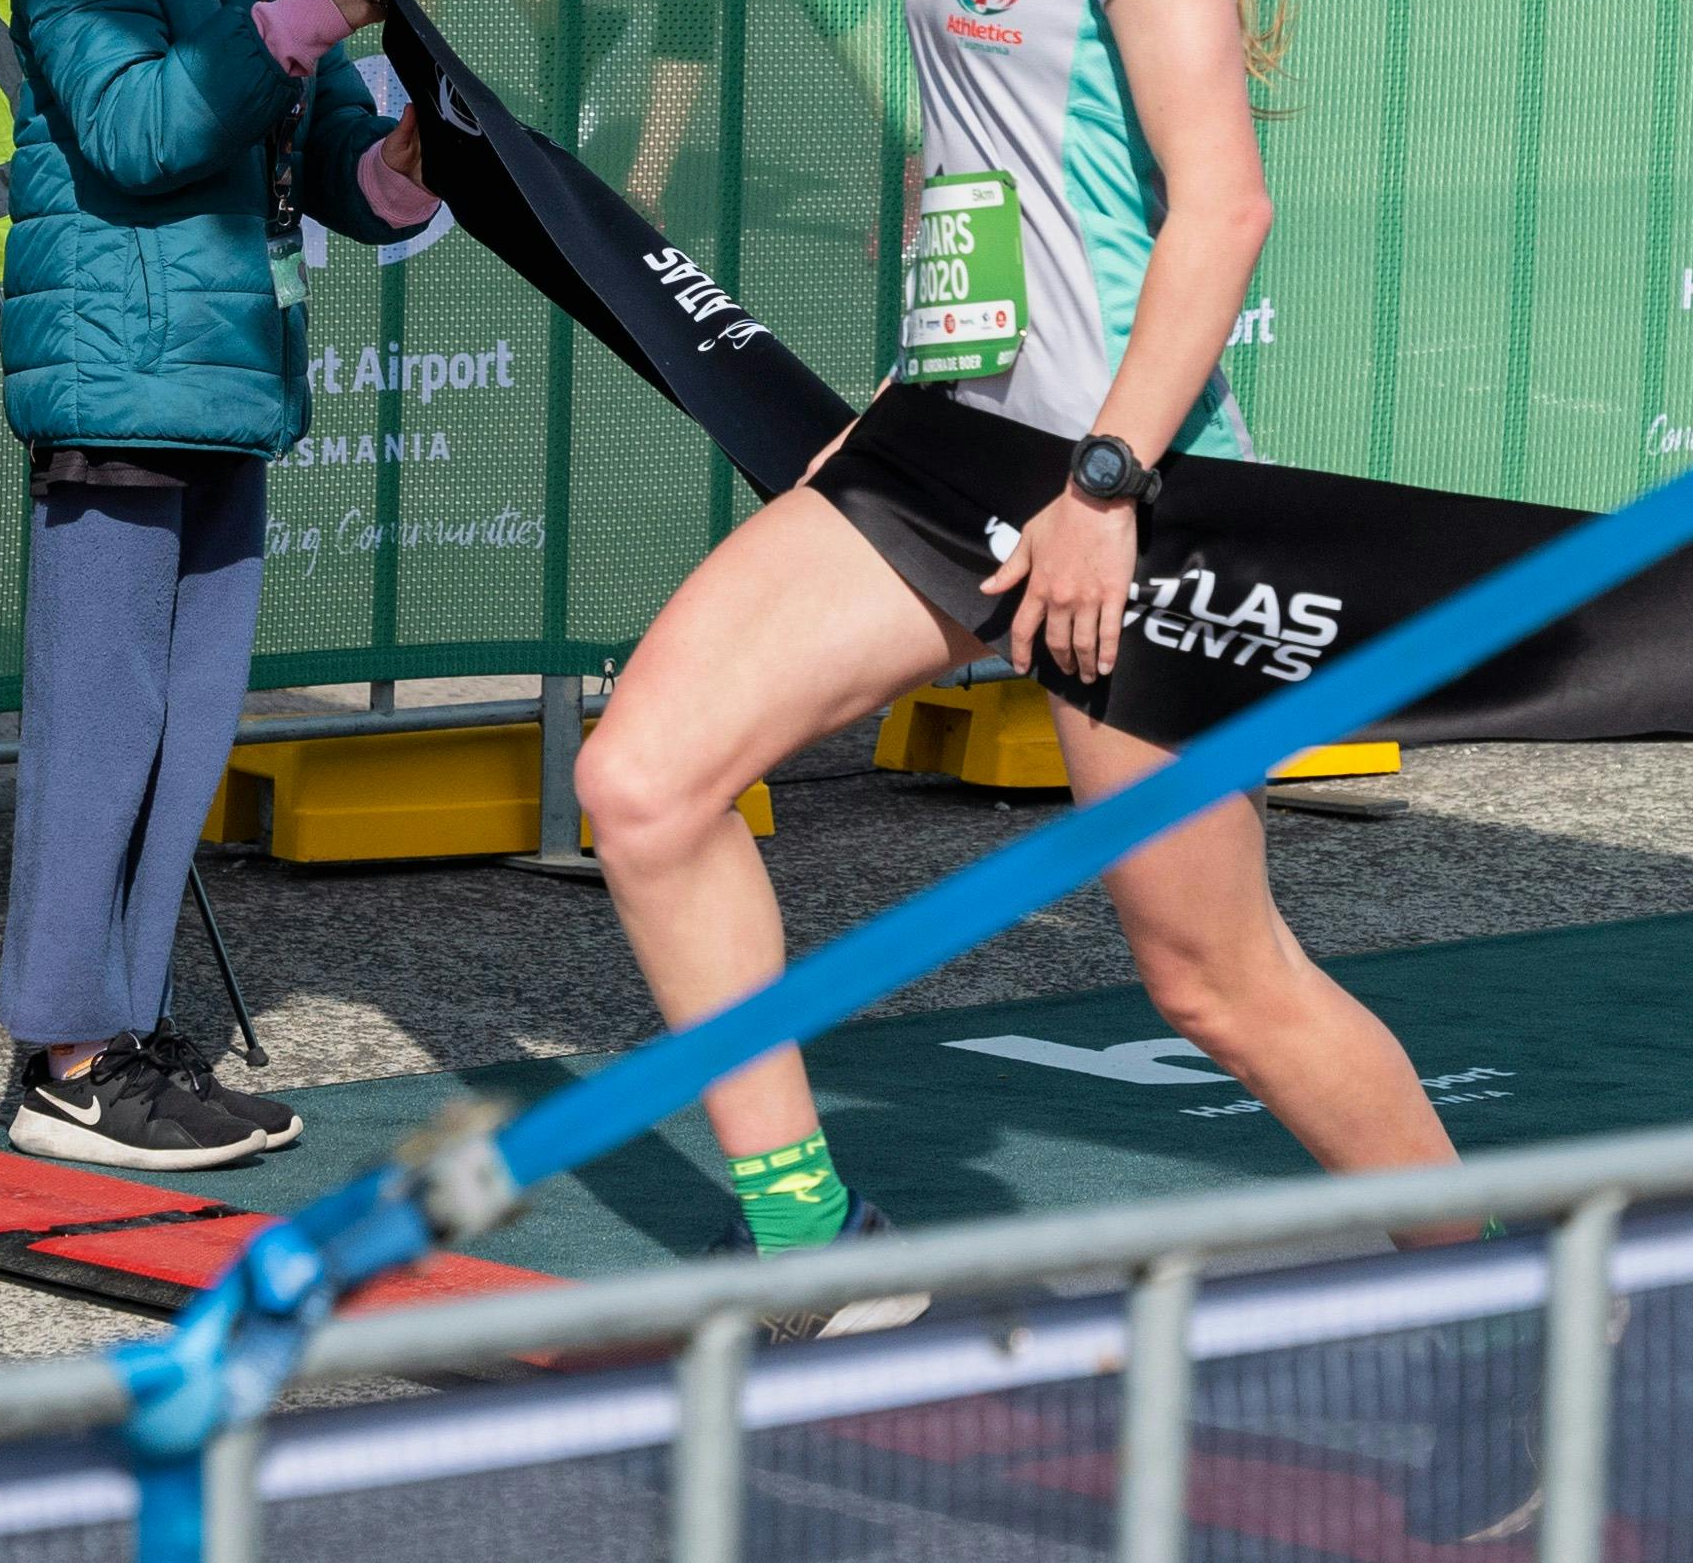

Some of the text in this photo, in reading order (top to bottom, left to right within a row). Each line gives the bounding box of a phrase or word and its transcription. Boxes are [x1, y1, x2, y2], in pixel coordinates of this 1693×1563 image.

[946, 14, 1022, 45] Athletics
[643, 247, 742, 323] ATLAS
[918, 258, 970, 304] 8020
[353, 339, 514, 405] Airport
[267, 432, 450, 468] SMANIA
[1128, 568, 1343, 647] TLAS
[1123, 606, 1322, 682] ENTS
[1419, 1067, 1516, 1089] port
